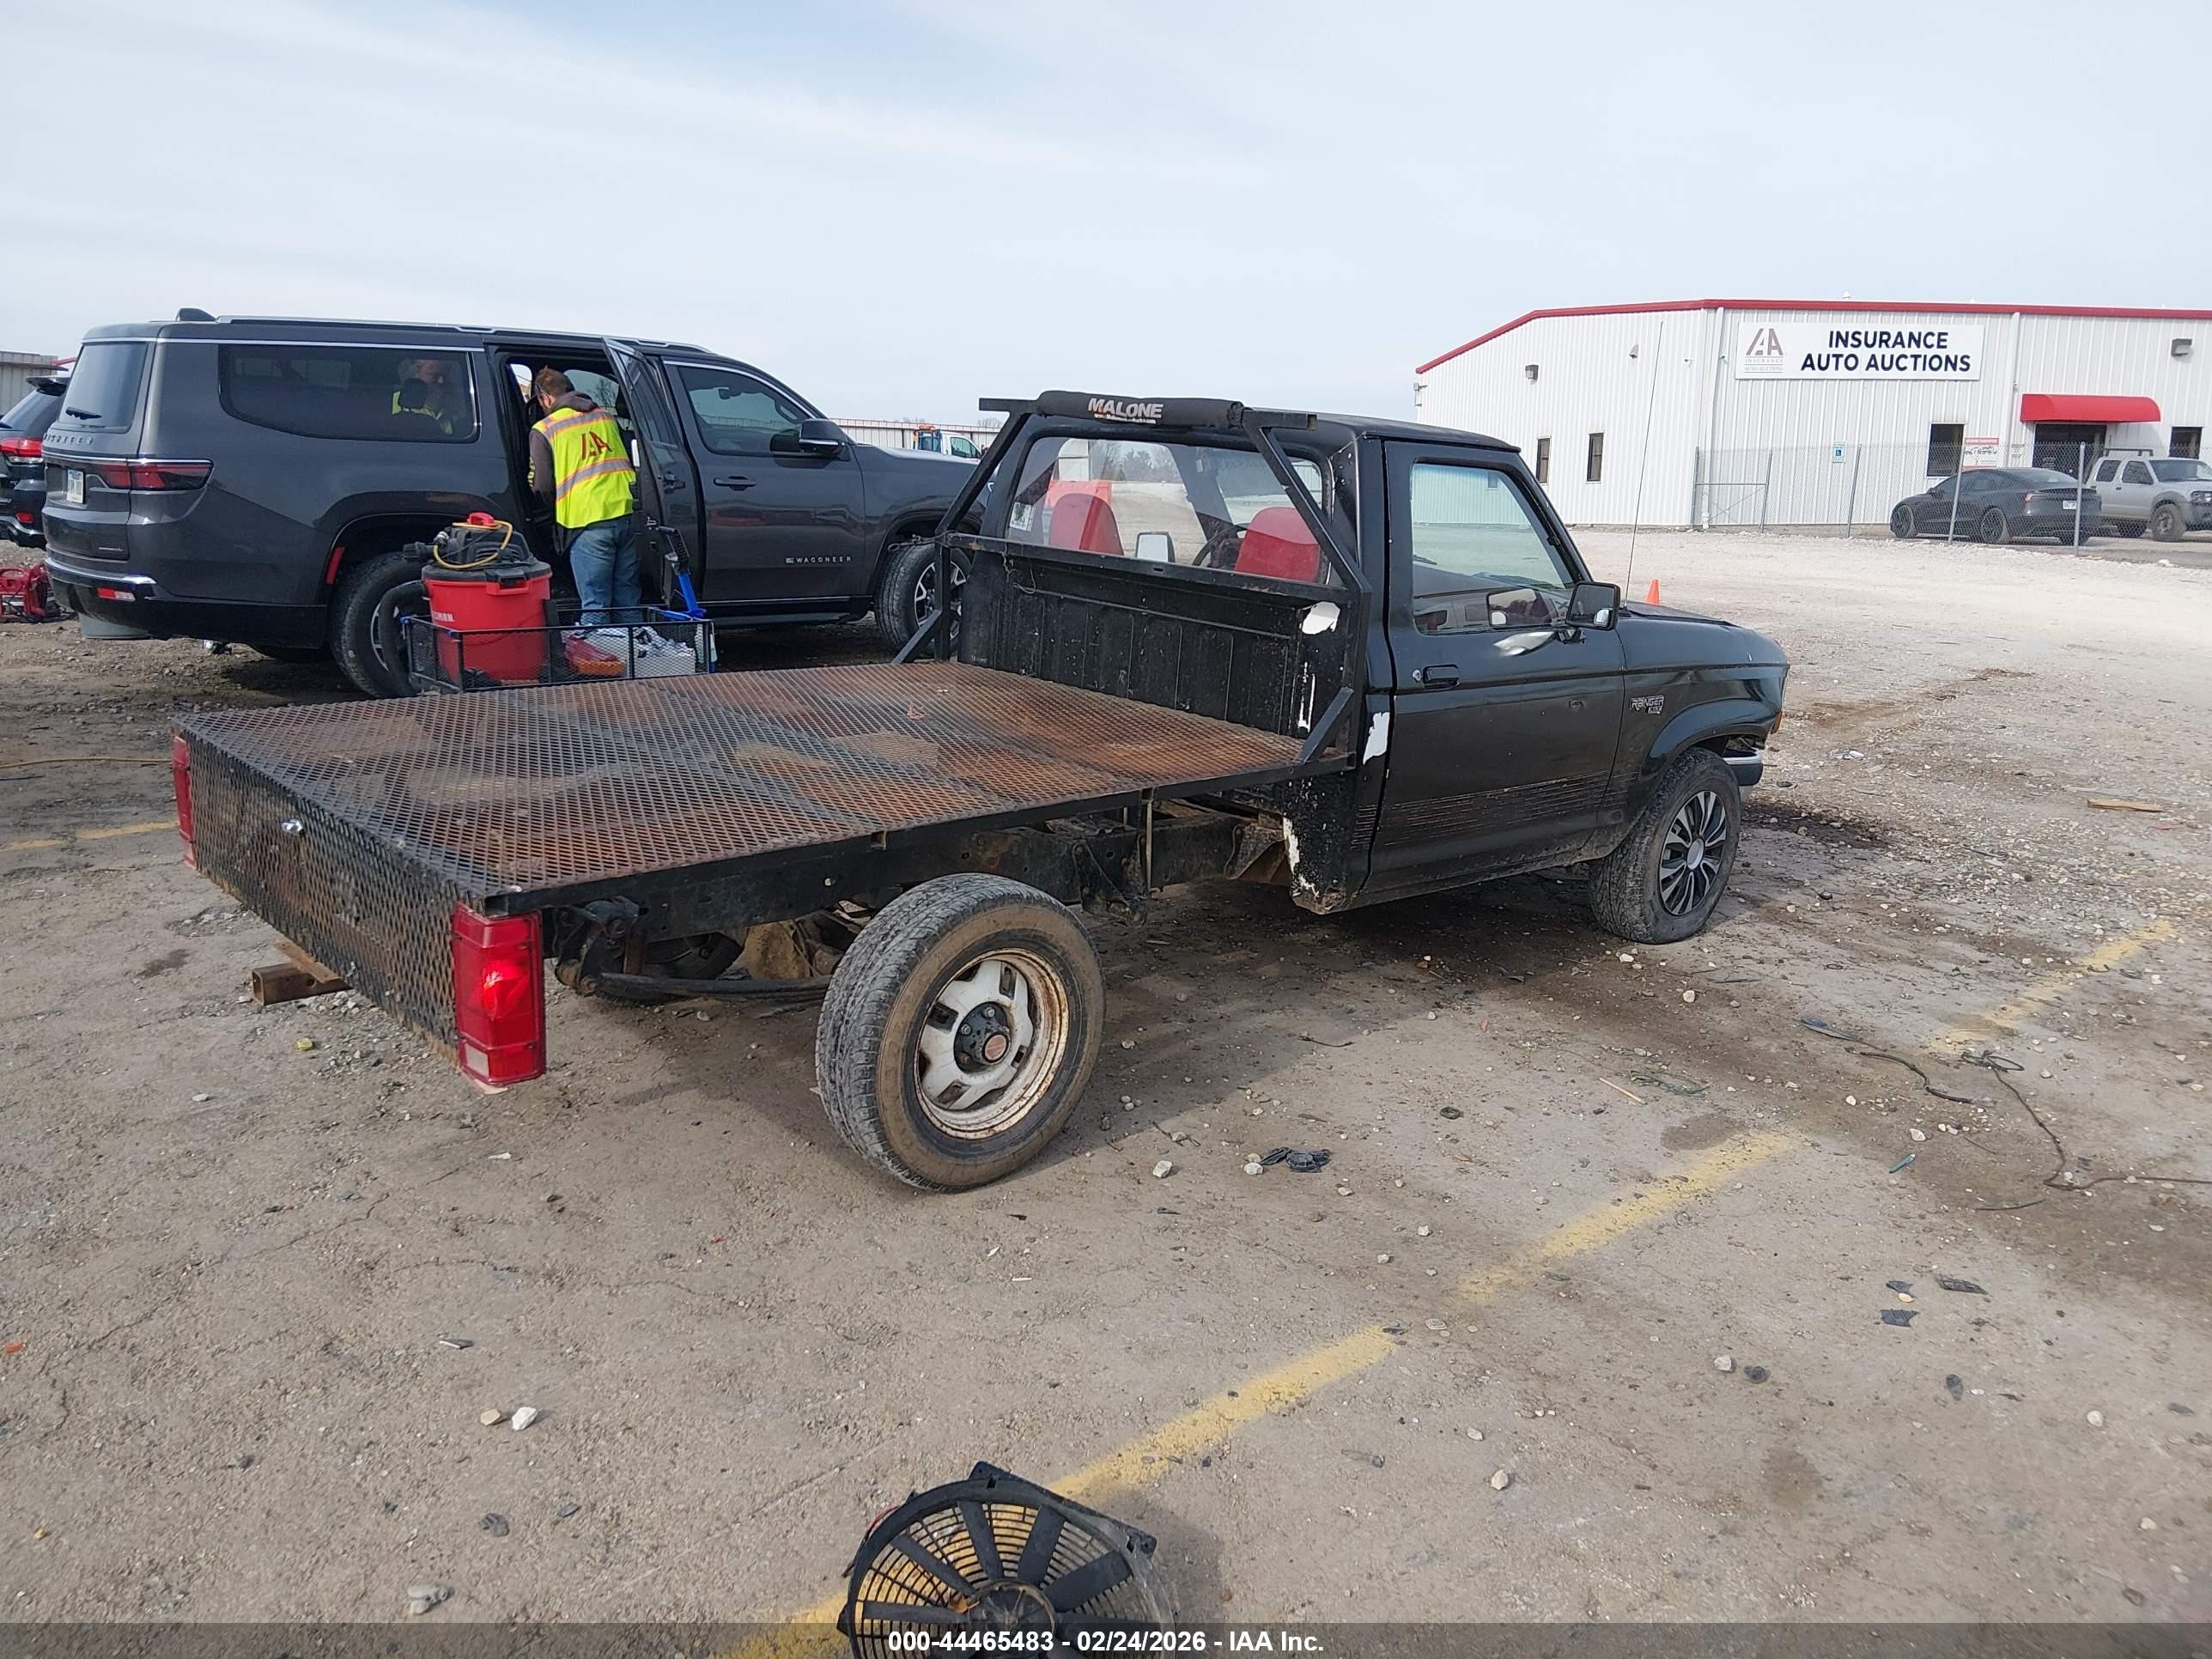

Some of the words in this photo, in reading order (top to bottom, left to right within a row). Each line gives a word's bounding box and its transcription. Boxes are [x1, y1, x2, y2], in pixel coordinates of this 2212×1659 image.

[1829, 330, 1948, 349] INSURANCE
[1801, 353, 1859, 372] AUTO
[1865, 354, 1971, 372] AUCTIONS
[1088, 398, 1164, 418] MALONE
[1630, 695, 1664, 711] RANGER
